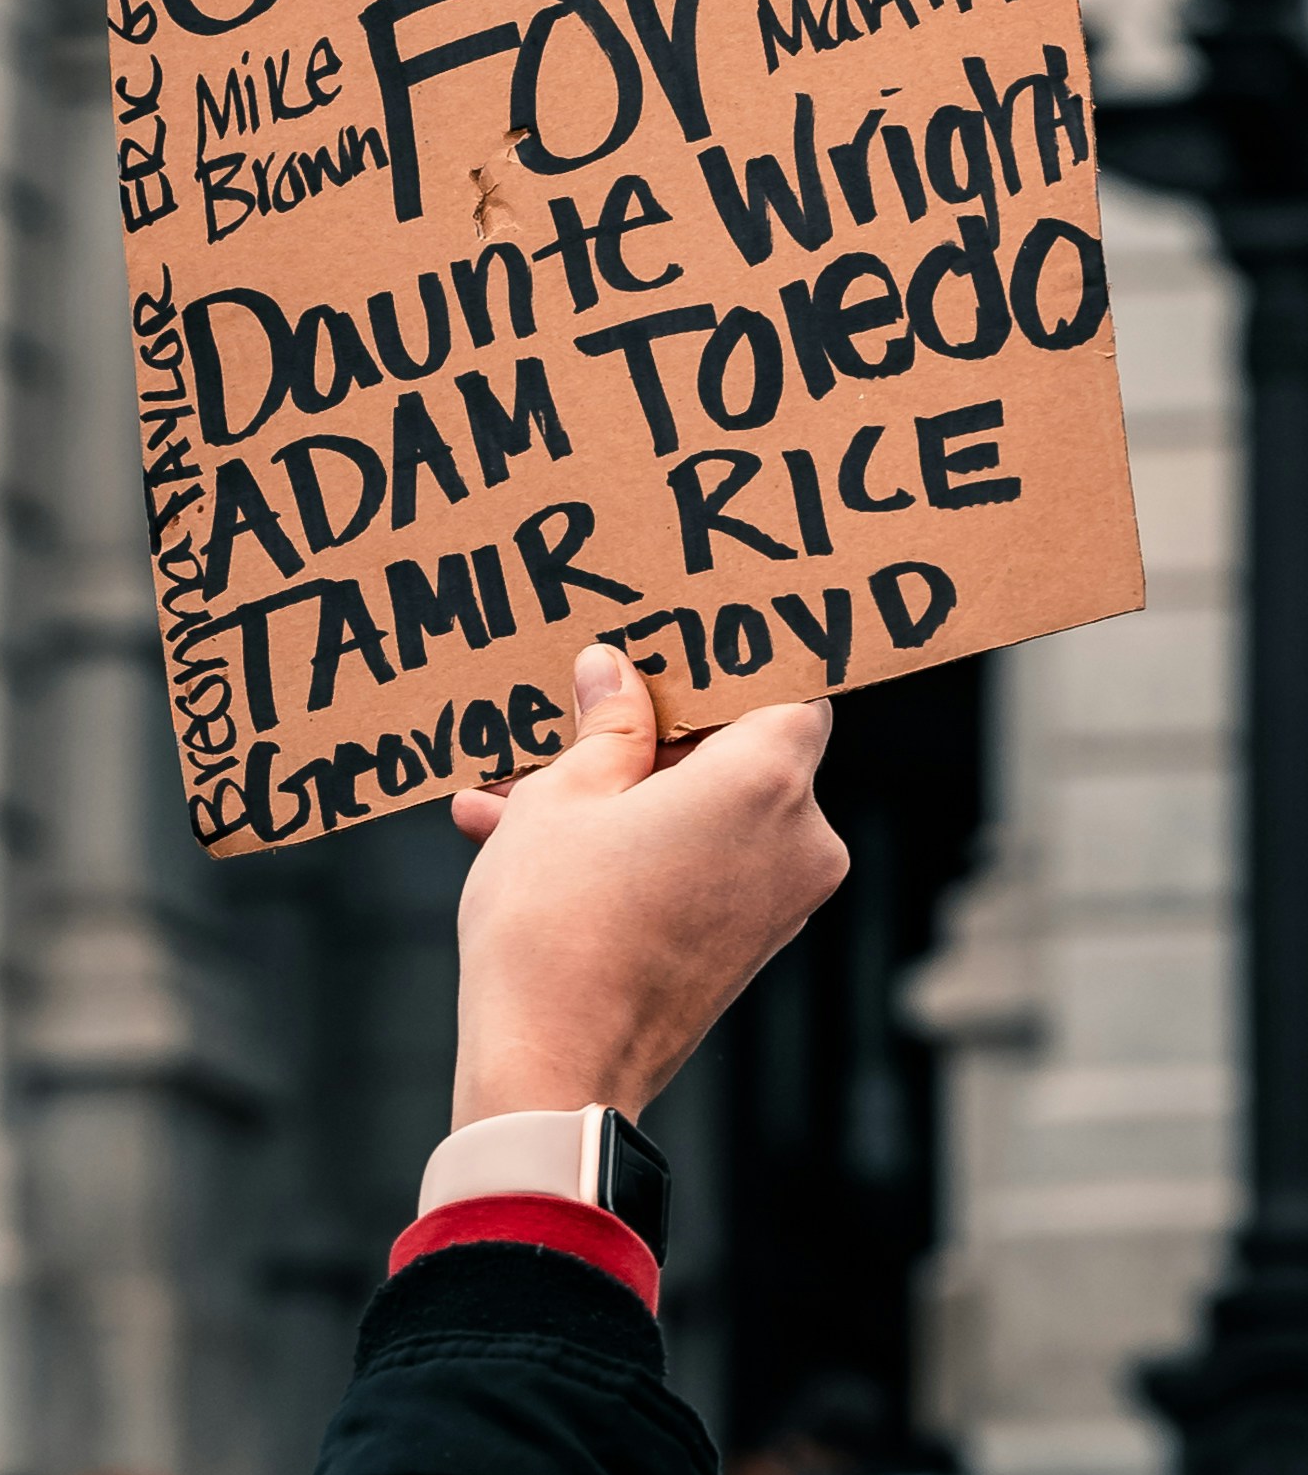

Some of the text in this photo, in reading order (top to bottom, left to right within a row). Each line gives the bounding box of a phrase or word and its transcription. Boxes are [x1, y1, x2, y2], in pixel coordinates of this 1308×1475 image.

[115, 55, 179, 234] ERIC
[195, 37, 343, 150] Mike
[195, 125, 390, 245] Brown
[181, 44, 1089, 448] Daunte Wright
[133, 263, 207, 555] TAYLOR
[198, 356, 573, 601] ADAM
[187, 398, 1022, 734] TAMIR RICE
